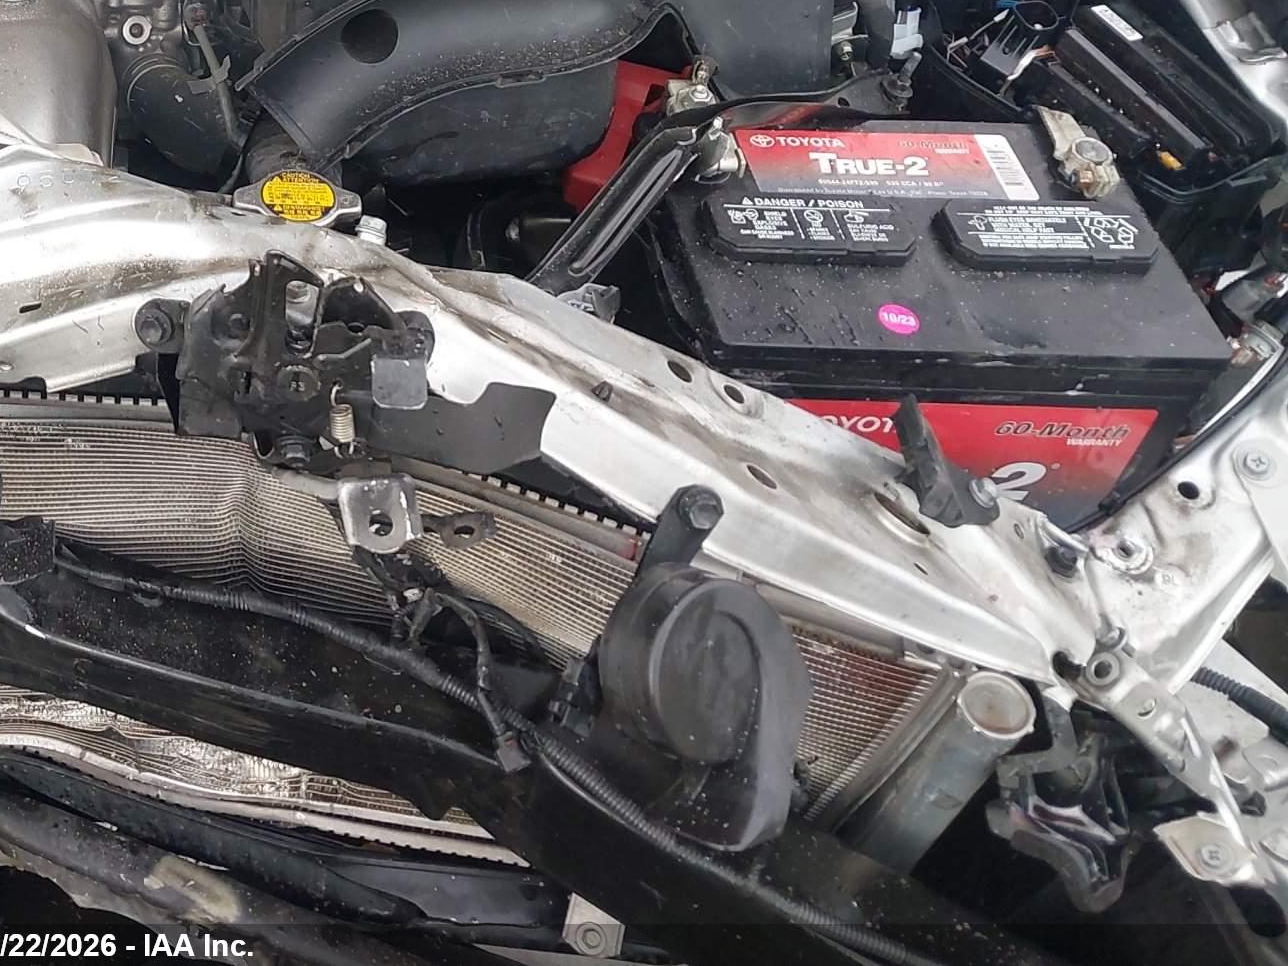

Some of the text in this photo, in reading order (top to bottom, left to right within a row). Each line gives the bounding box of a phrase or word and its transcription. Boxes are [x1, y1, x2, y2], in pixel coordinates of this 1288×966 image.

[775, 136, 846, 148] TOYOTA
[754, 197, 806, 207] DANGER
[818, 200, 864, 209] POISON
[882, 312, 916, 326] 10/23
[995, 421, 1130, 439] 60-Month
[1066, 438, 1122, 446] WARRANTY
